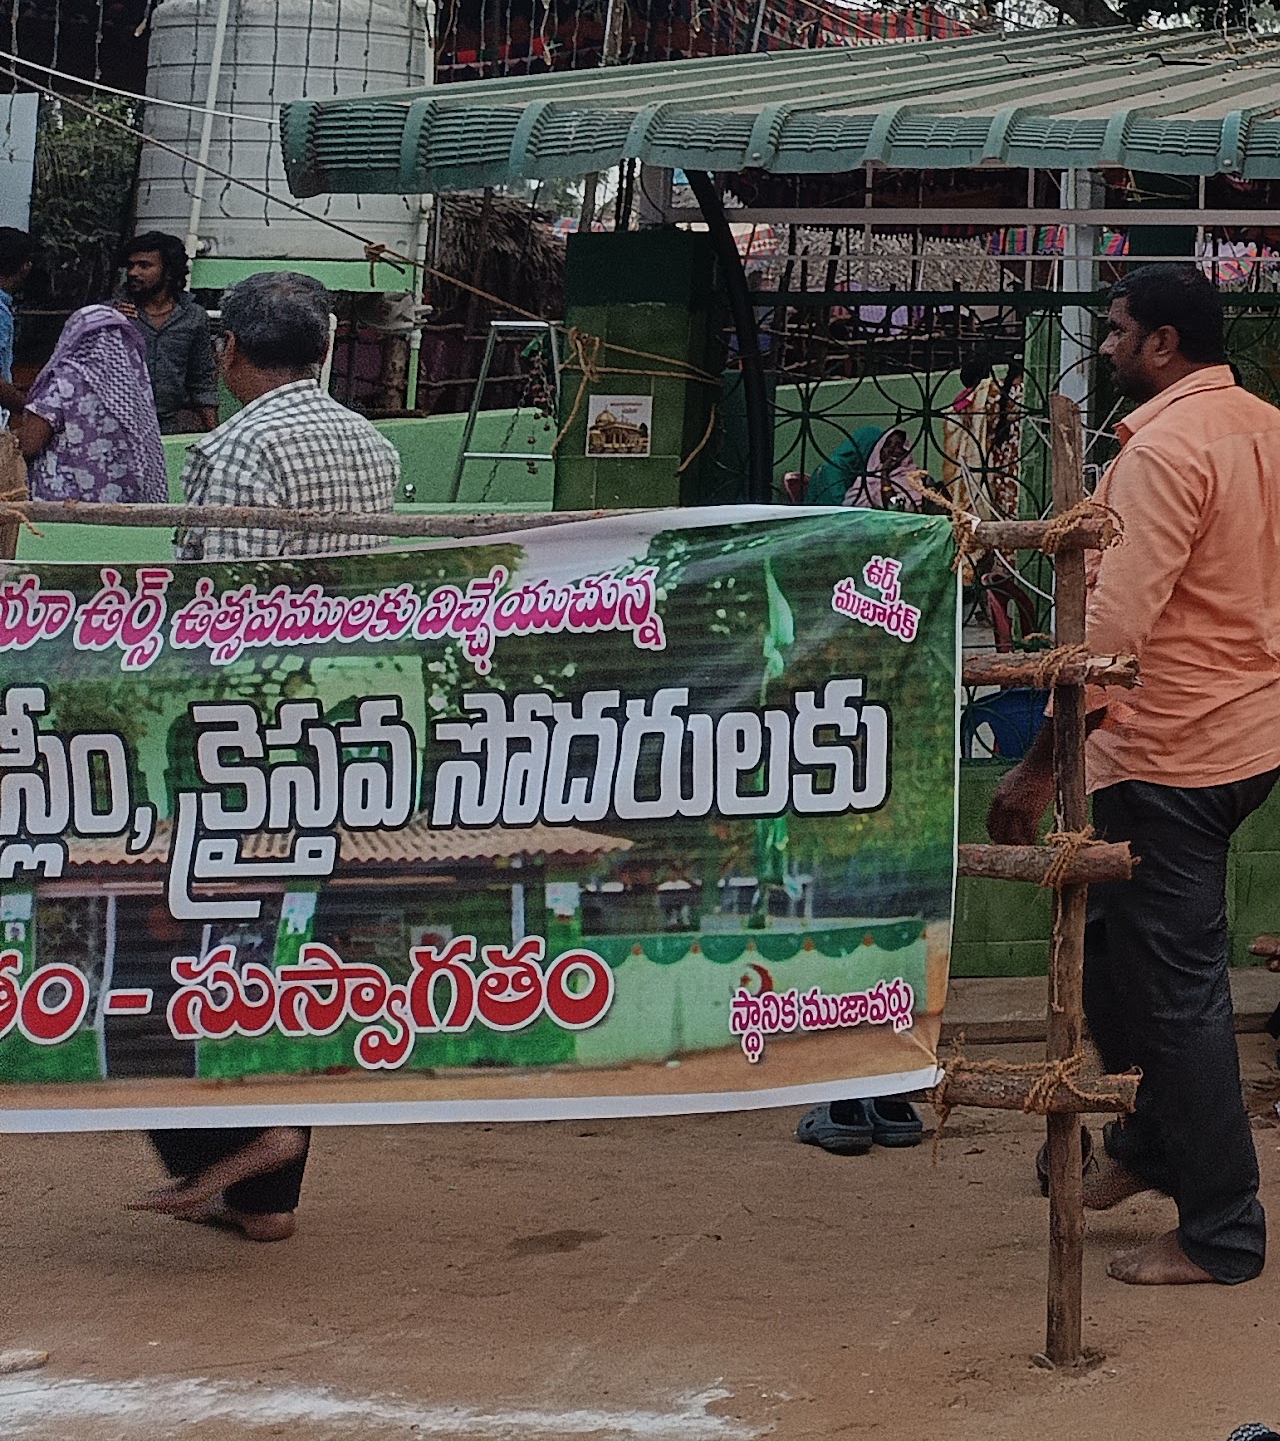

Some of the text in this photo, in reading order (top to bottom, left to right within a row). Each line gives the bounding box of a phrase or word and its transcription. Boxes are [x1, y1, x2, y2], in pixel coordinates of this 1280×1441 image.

[176, 580, 416, 662] ఉత్సవములకు
[835, 580, 918, 639] ముబారక్
[431, 677, 888, 828] సోదరులకు
[171, 938, 611, 1066] సుస్వాగతం
[732, 978, 912, 1060] స్థానిక ముజావర్లు
